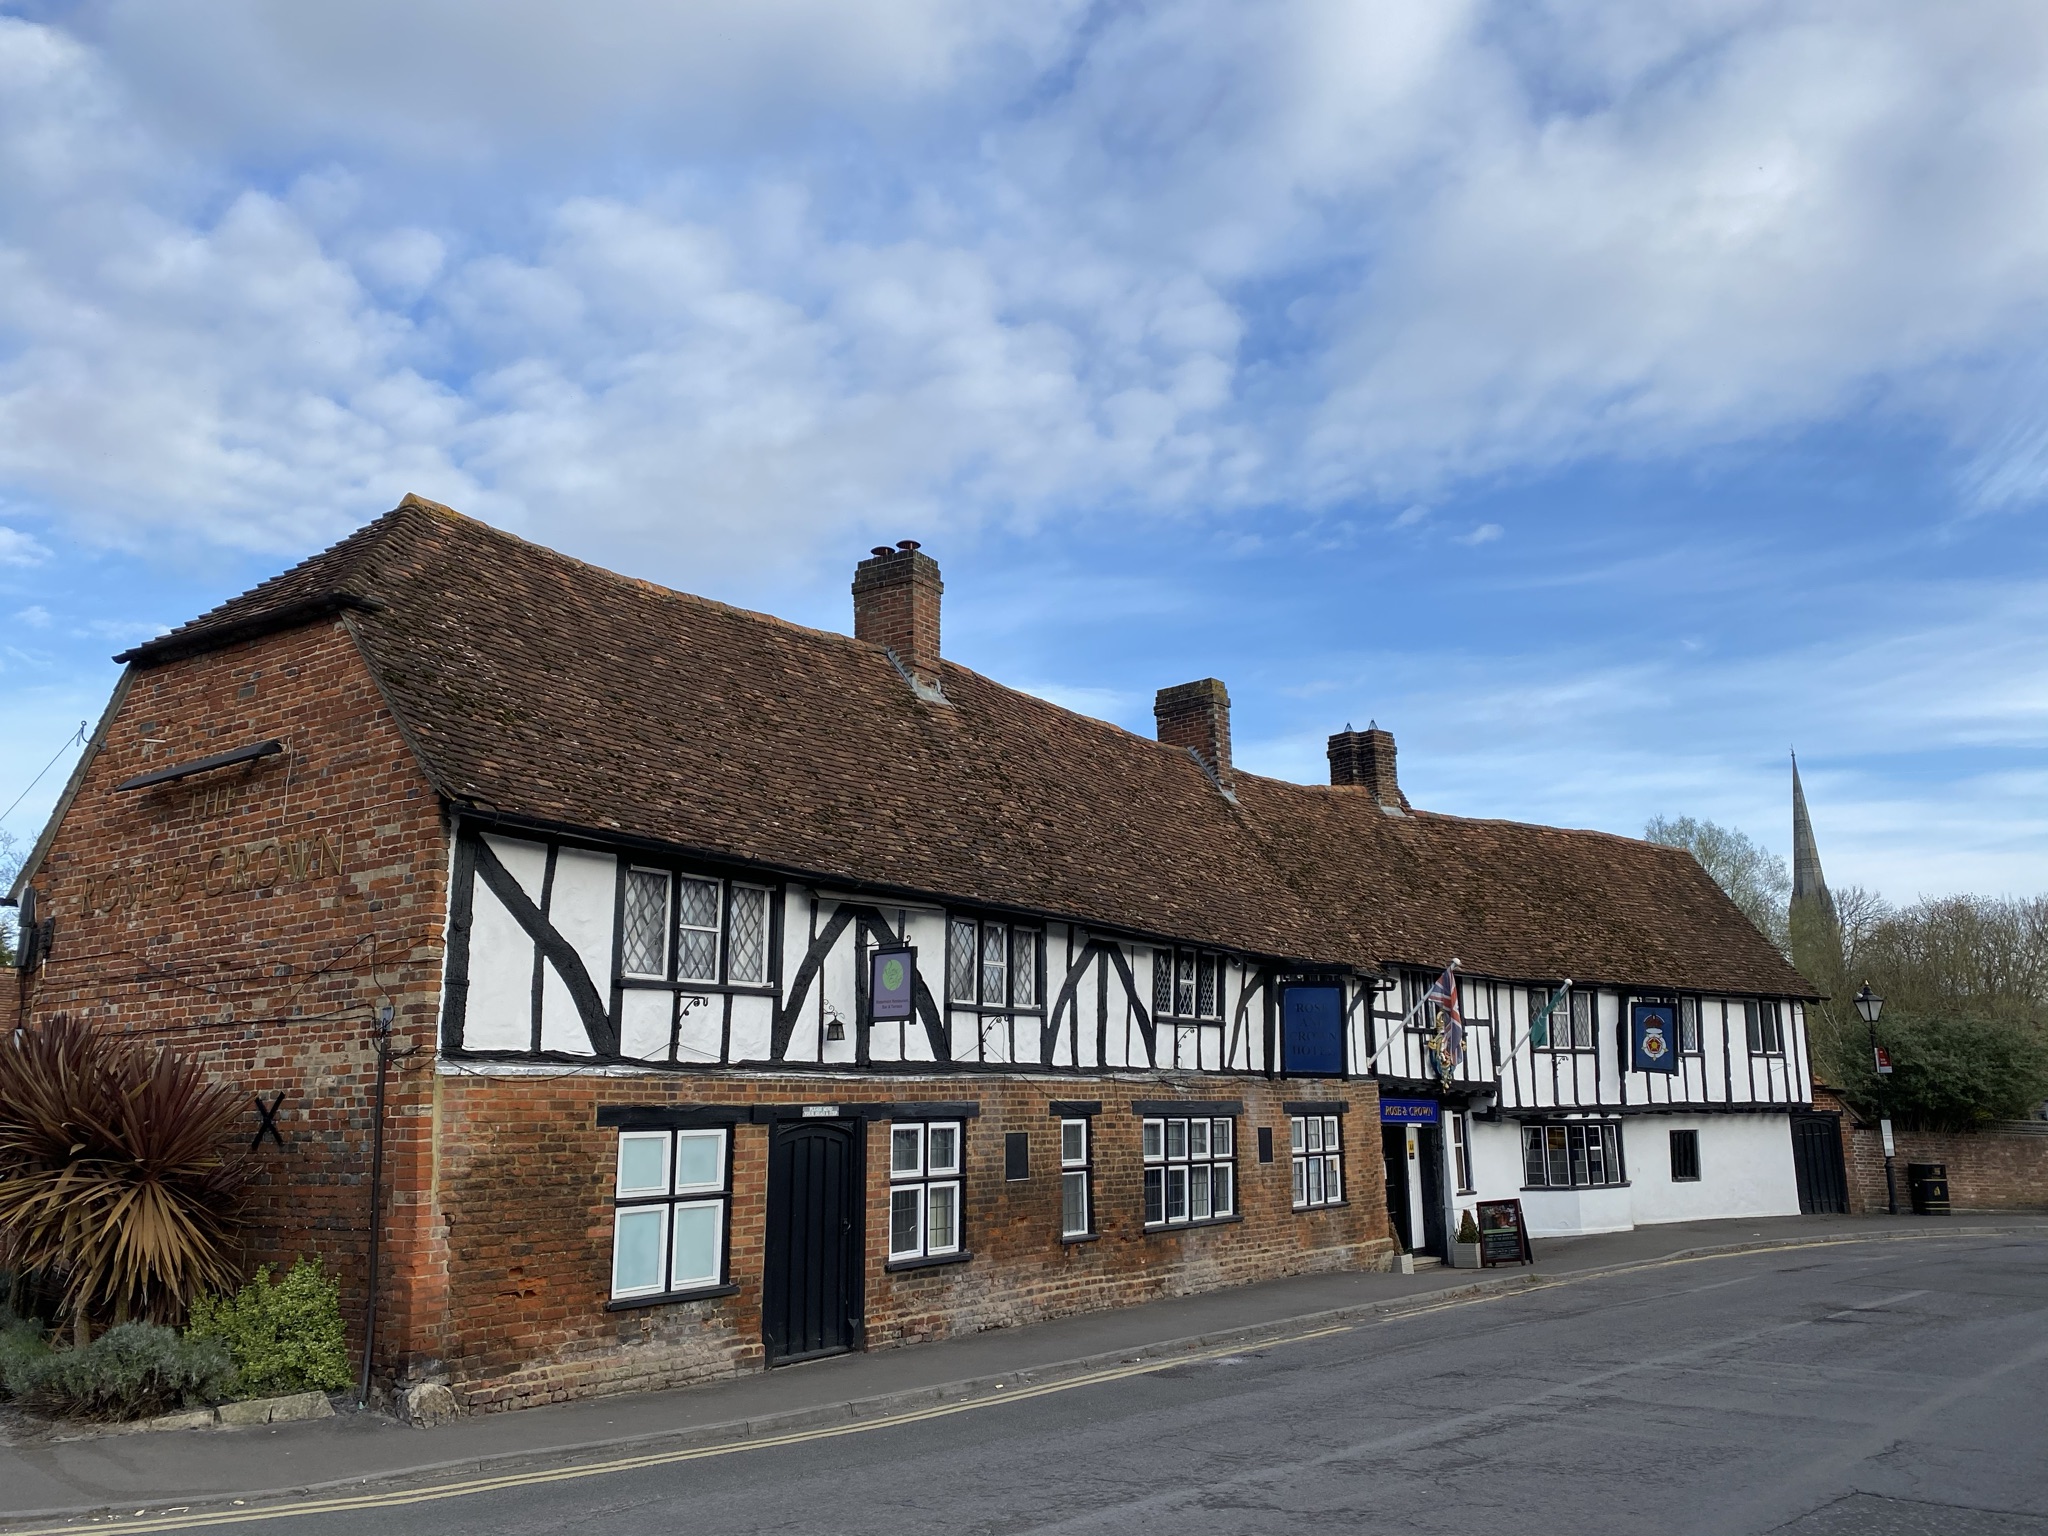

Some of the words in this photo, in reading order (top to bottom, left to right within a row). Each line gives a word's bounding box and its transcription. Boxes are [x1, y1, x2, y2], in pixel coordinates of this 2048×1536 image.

[189, 782, 237, 820] THE
[81, 862, 156, 915] ROSE
[169, 861, 191, 902] &
[204, 824, 351, 897] CROWN
[1385, 1106, 1402, 1116] ROSE
[1402, 1106, 1407, 1116] &
[1409, 1107, 1433, 1117] CROWN
